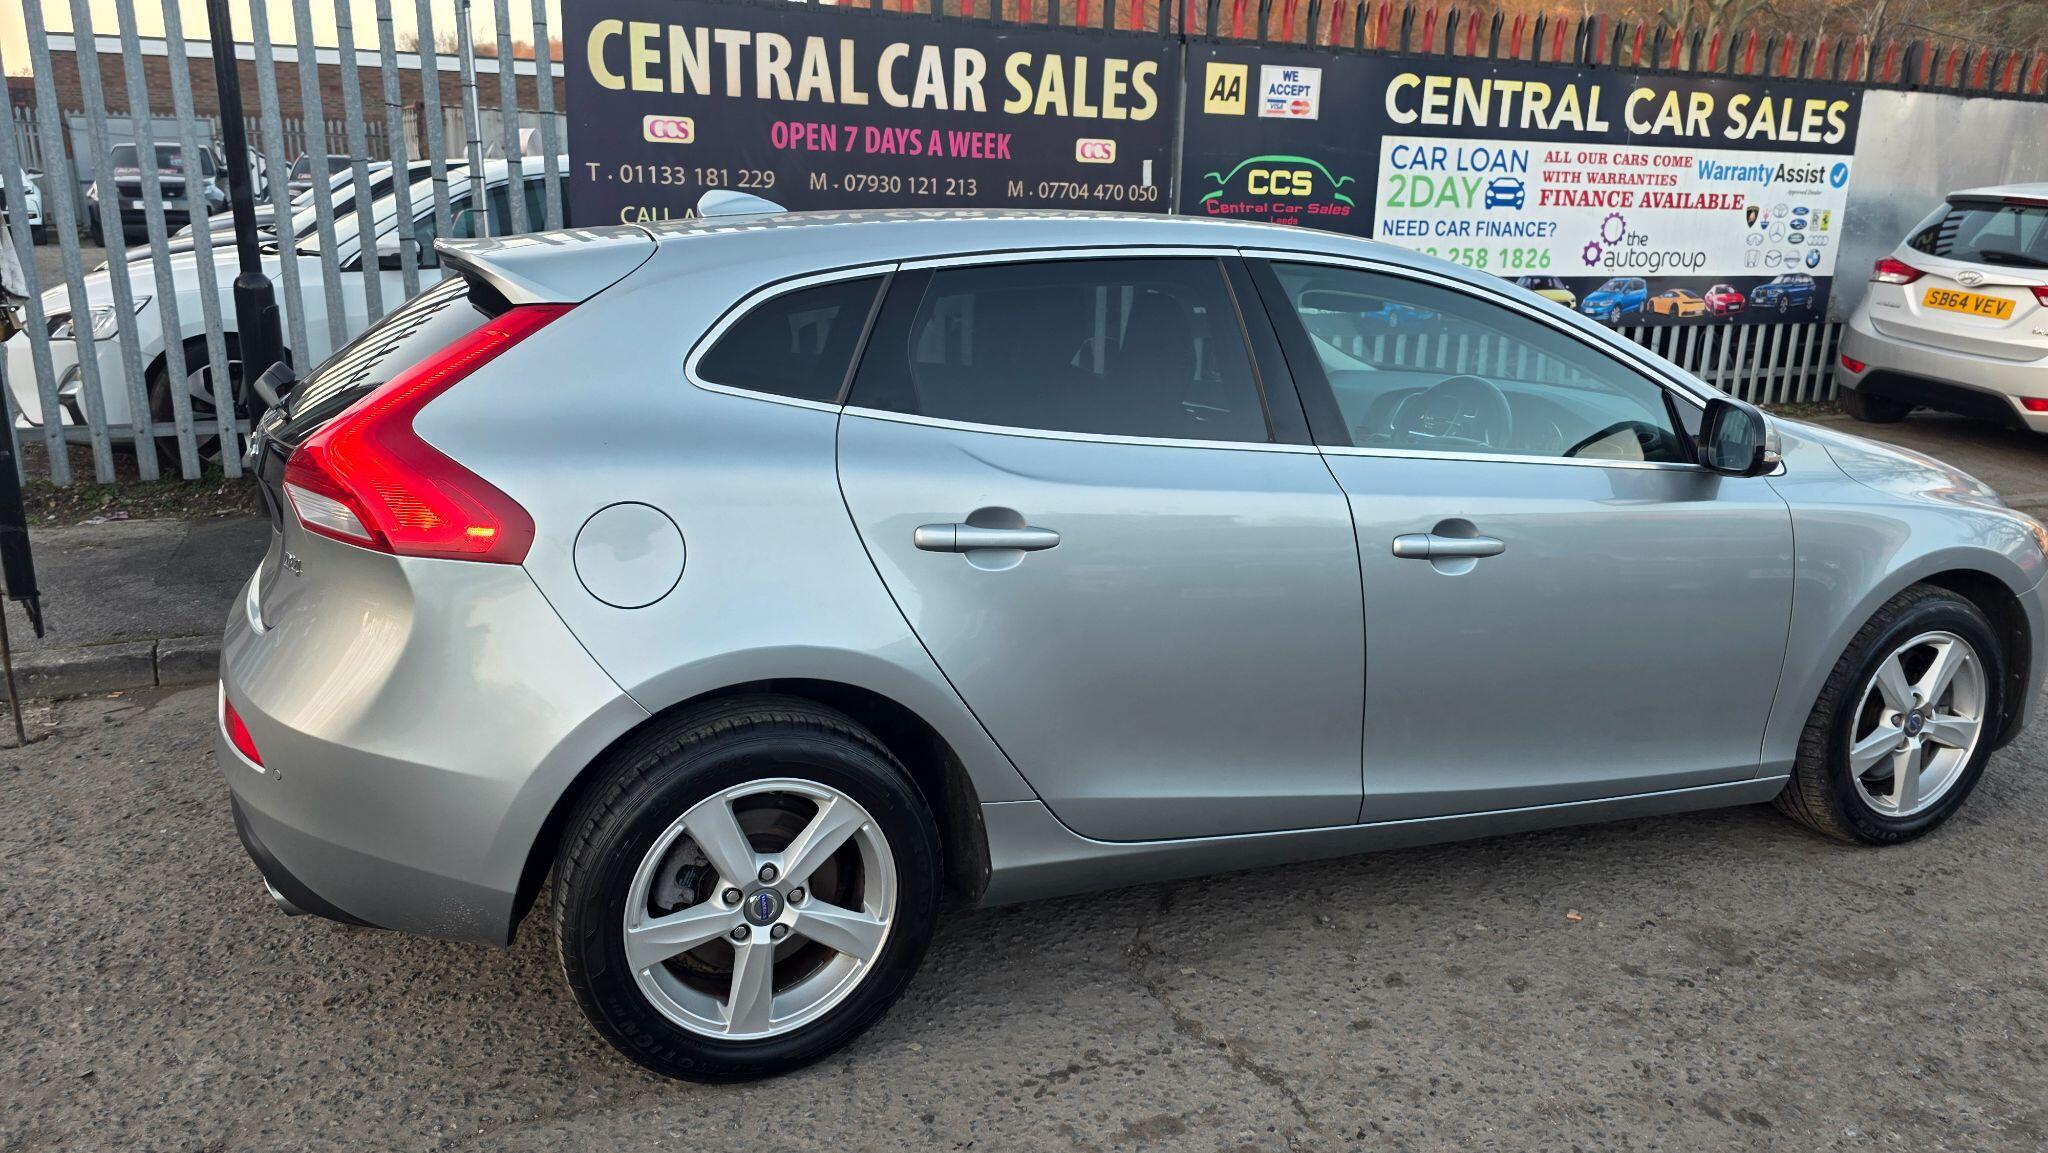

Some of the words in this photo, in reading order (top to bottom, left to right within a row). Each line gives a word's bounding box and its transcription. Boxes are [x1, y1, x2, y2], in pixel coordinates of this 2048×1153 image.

[587, 19, 869, 105] CENTRAL
[877, 43, 987, 112] CAR
[1003, 52, 1158, 121] SALES
[1283, 70, 1299, 82] WE
[1210, 75, 1241, 102] AA
[1269, 83, 1311, 97] ACCEPT
[1385, 73, 1610, 132] CENTRAL
[1624, 87, 1714, 138] CAR
[1723, 94, 1850, 145] SALES
[650, 120, 689, 139] CCS
[771, 121, 836, 151] OPEN
[843, 126, 858, 152] 7
[865, 127, 922, 156] DAYS
[928, 130, 942, 157] A
[948, 130, 1013, 160] WEEK
[1080, 142, 1111, 160] CCS
[1391, 144, 1448, 171] CAR
[1457, 147, 1529, 173] LOAN
[1544, 151, 1572, 163] ALL
[1577, 152, 1608, 165] OUR
[1613, 153, 1648, 167] CARS
[1653, 155, 1693, 168] COME
[620, 165, 686, 186] 01133
[695, 168, 728, 187] 181
[738, 170, 776, 189] 229
[844, 174, 901, 193] 07930
[908, 177, 937, 195] 121
[945, 178, 977, 197] 213
[1248, 169, 1312, 196] CCS
[1542, 171, 1582, 184] WITH
[1587, 172, 1678, 186] WARRANTIES
[1038, 182, 1089, 199] 07704
[1093, 184, 1123, 200] 470
[1128, 185, 1158, 202] 050
[1386, 174, 1483, 209] 2DAY
[1538, 189, 1634, 208] FINANCE
[1638, 191, 1745, 211] AVAILABLE
[1206, 199, 1268, 215] Central
[1272, 202, 1304, 213] Car
[1307, 203, 1350, 216] Sales
[1383, 219, 1430, 237] NEED
[1435, 220, 1470, 237] CAR
[1476, 221, 1557, 238] FINANCE?
[1627, 231, 1648, 247] the
[1450, 248, 1488, 269] 258
[1499, 248, 1551, 269] 1826
[1603, 247, 1706, 273] autogroup
[1929, 291, 1969, 309] SB64
[1974, 297, 2008, 315] VEV
